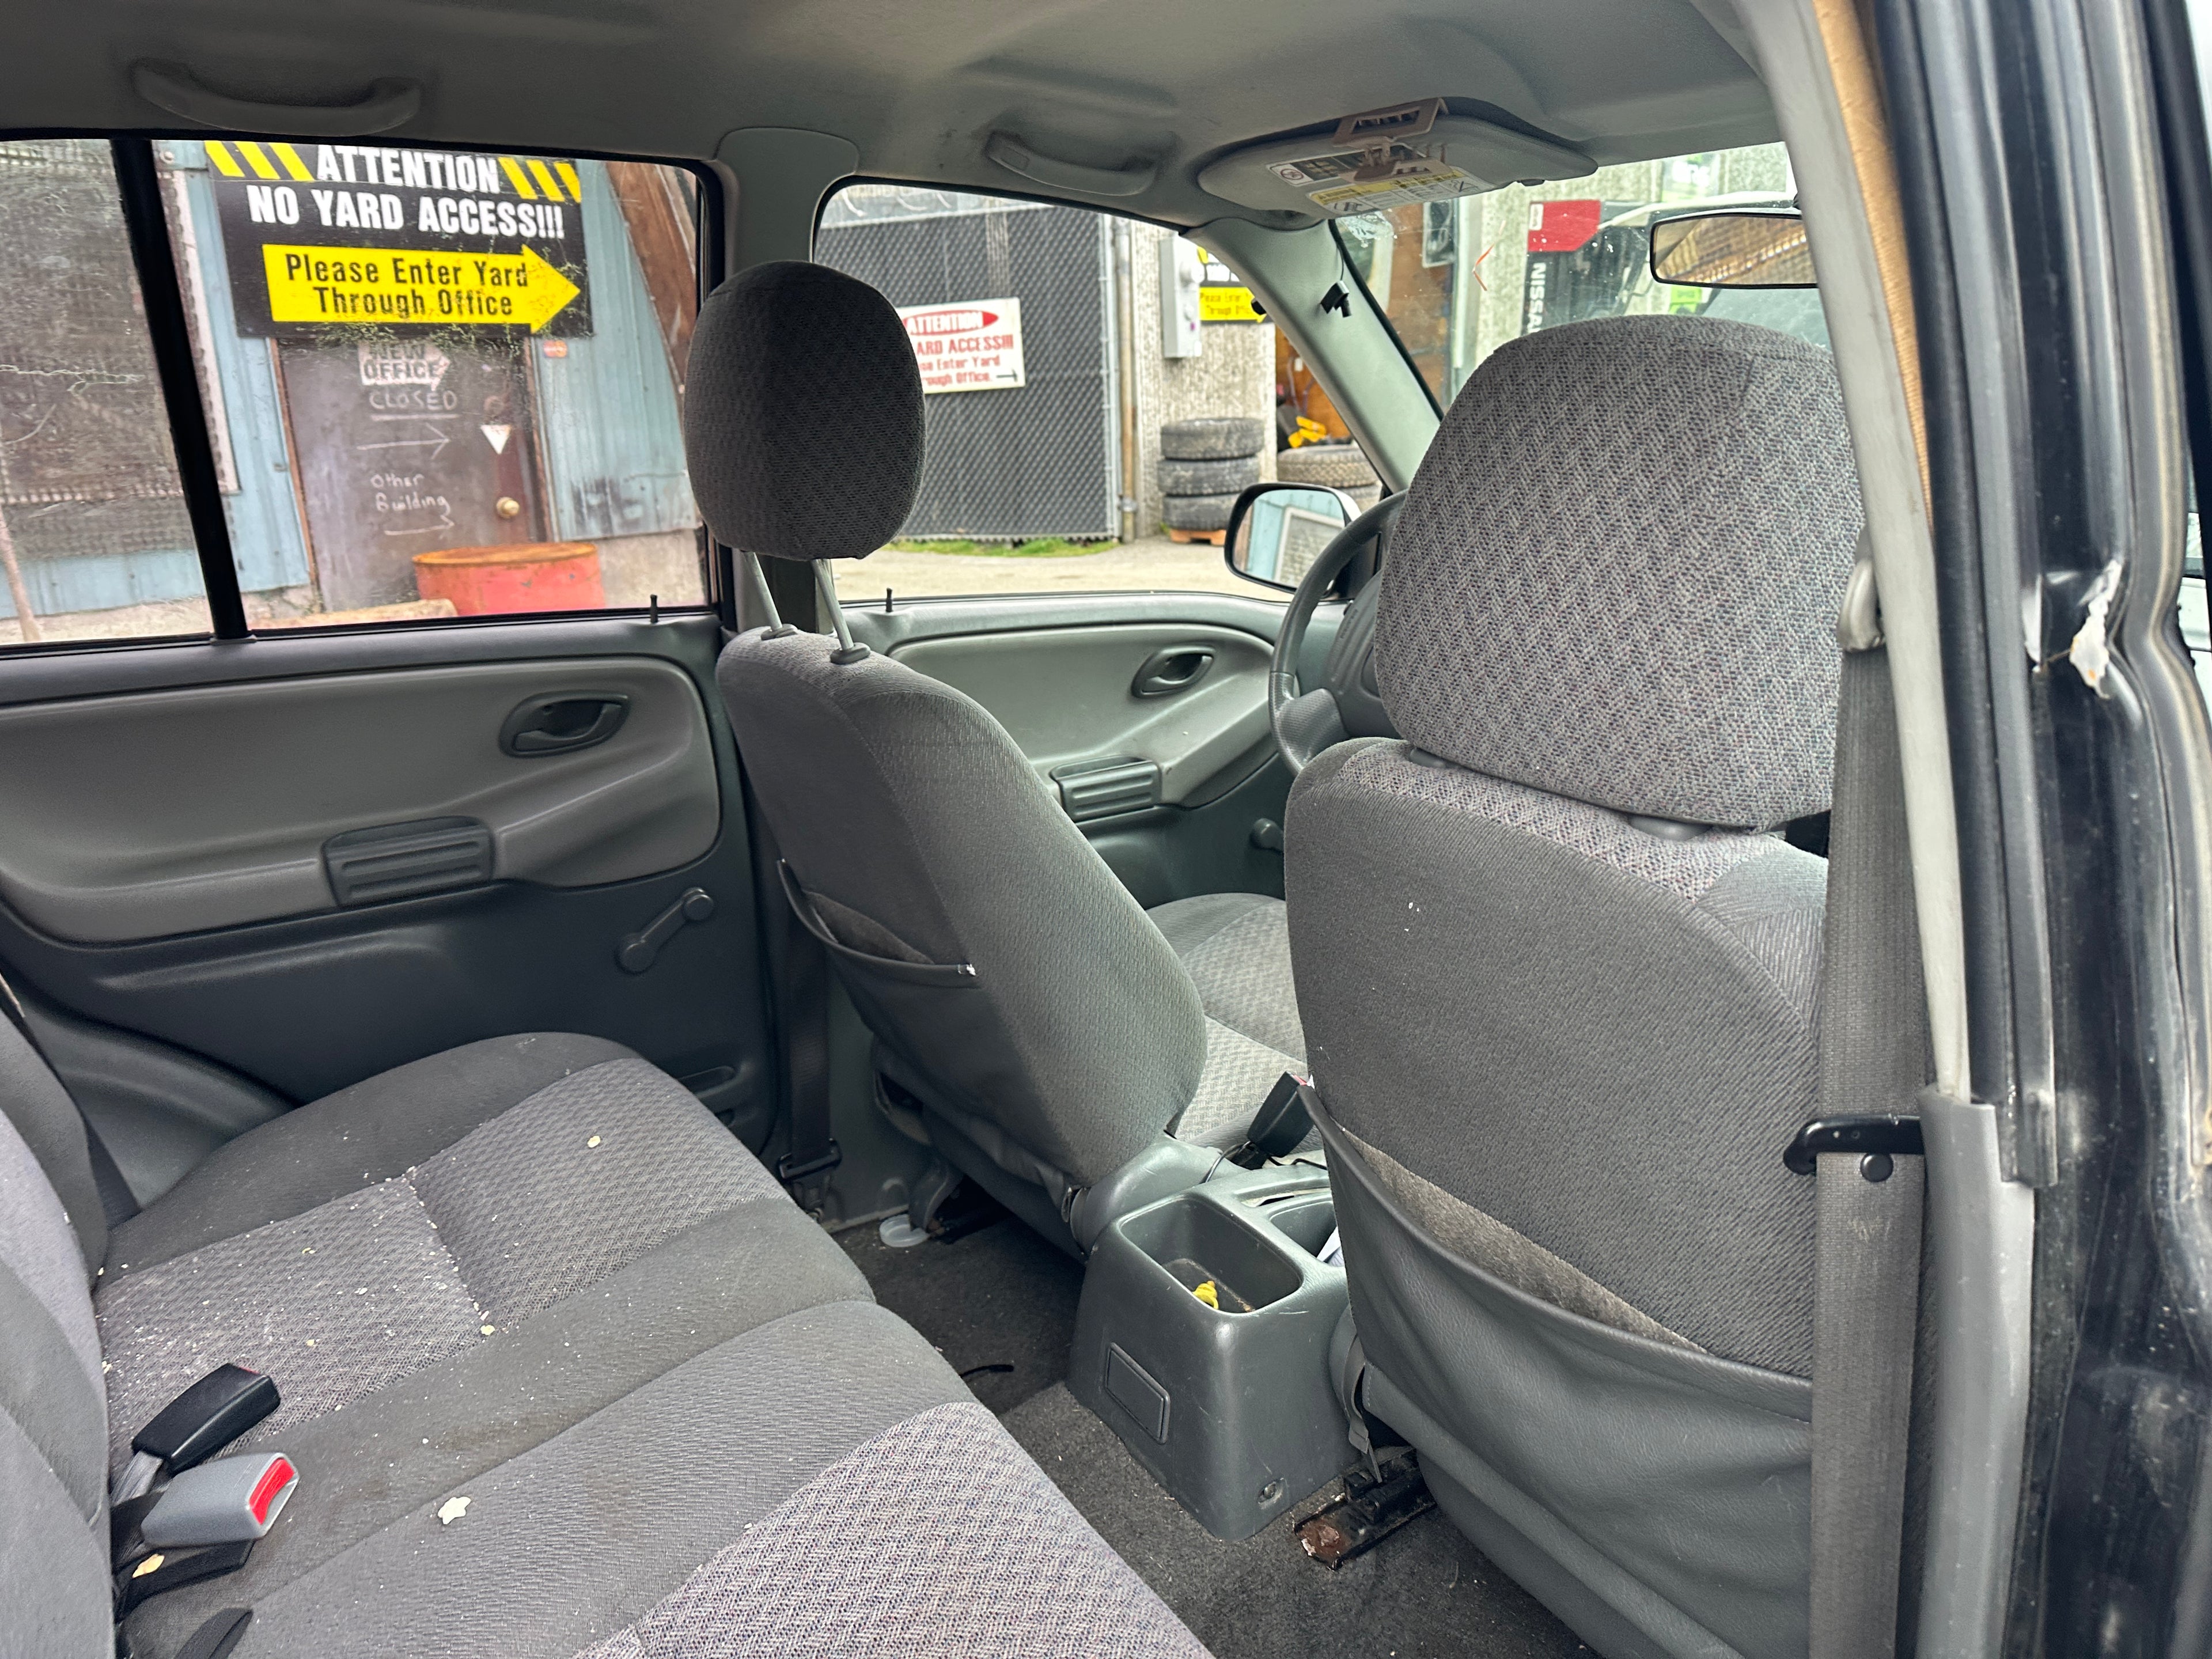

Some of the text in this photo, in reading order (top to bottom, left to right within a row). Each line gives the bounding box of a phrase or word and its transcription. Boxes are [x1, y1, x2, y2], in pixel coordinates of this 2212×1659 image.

[317, 145, 501, 194] ATTENTION
[247, 185, 565, 239] NO YARD ACCESS!!!
[286, 253, 529, 287] Please Enter Yard
[313, 286, 512, 317] Through Office
[906, 312, 983, 334] ATTENTION
[916, 341, 943, 355] ARD
[363, 358, 440, 379] OFFICE
[369, 388, 457, 410] CLOSED
[370, 473, 425, 488] Other
[376, 491, 450, 517] Building
